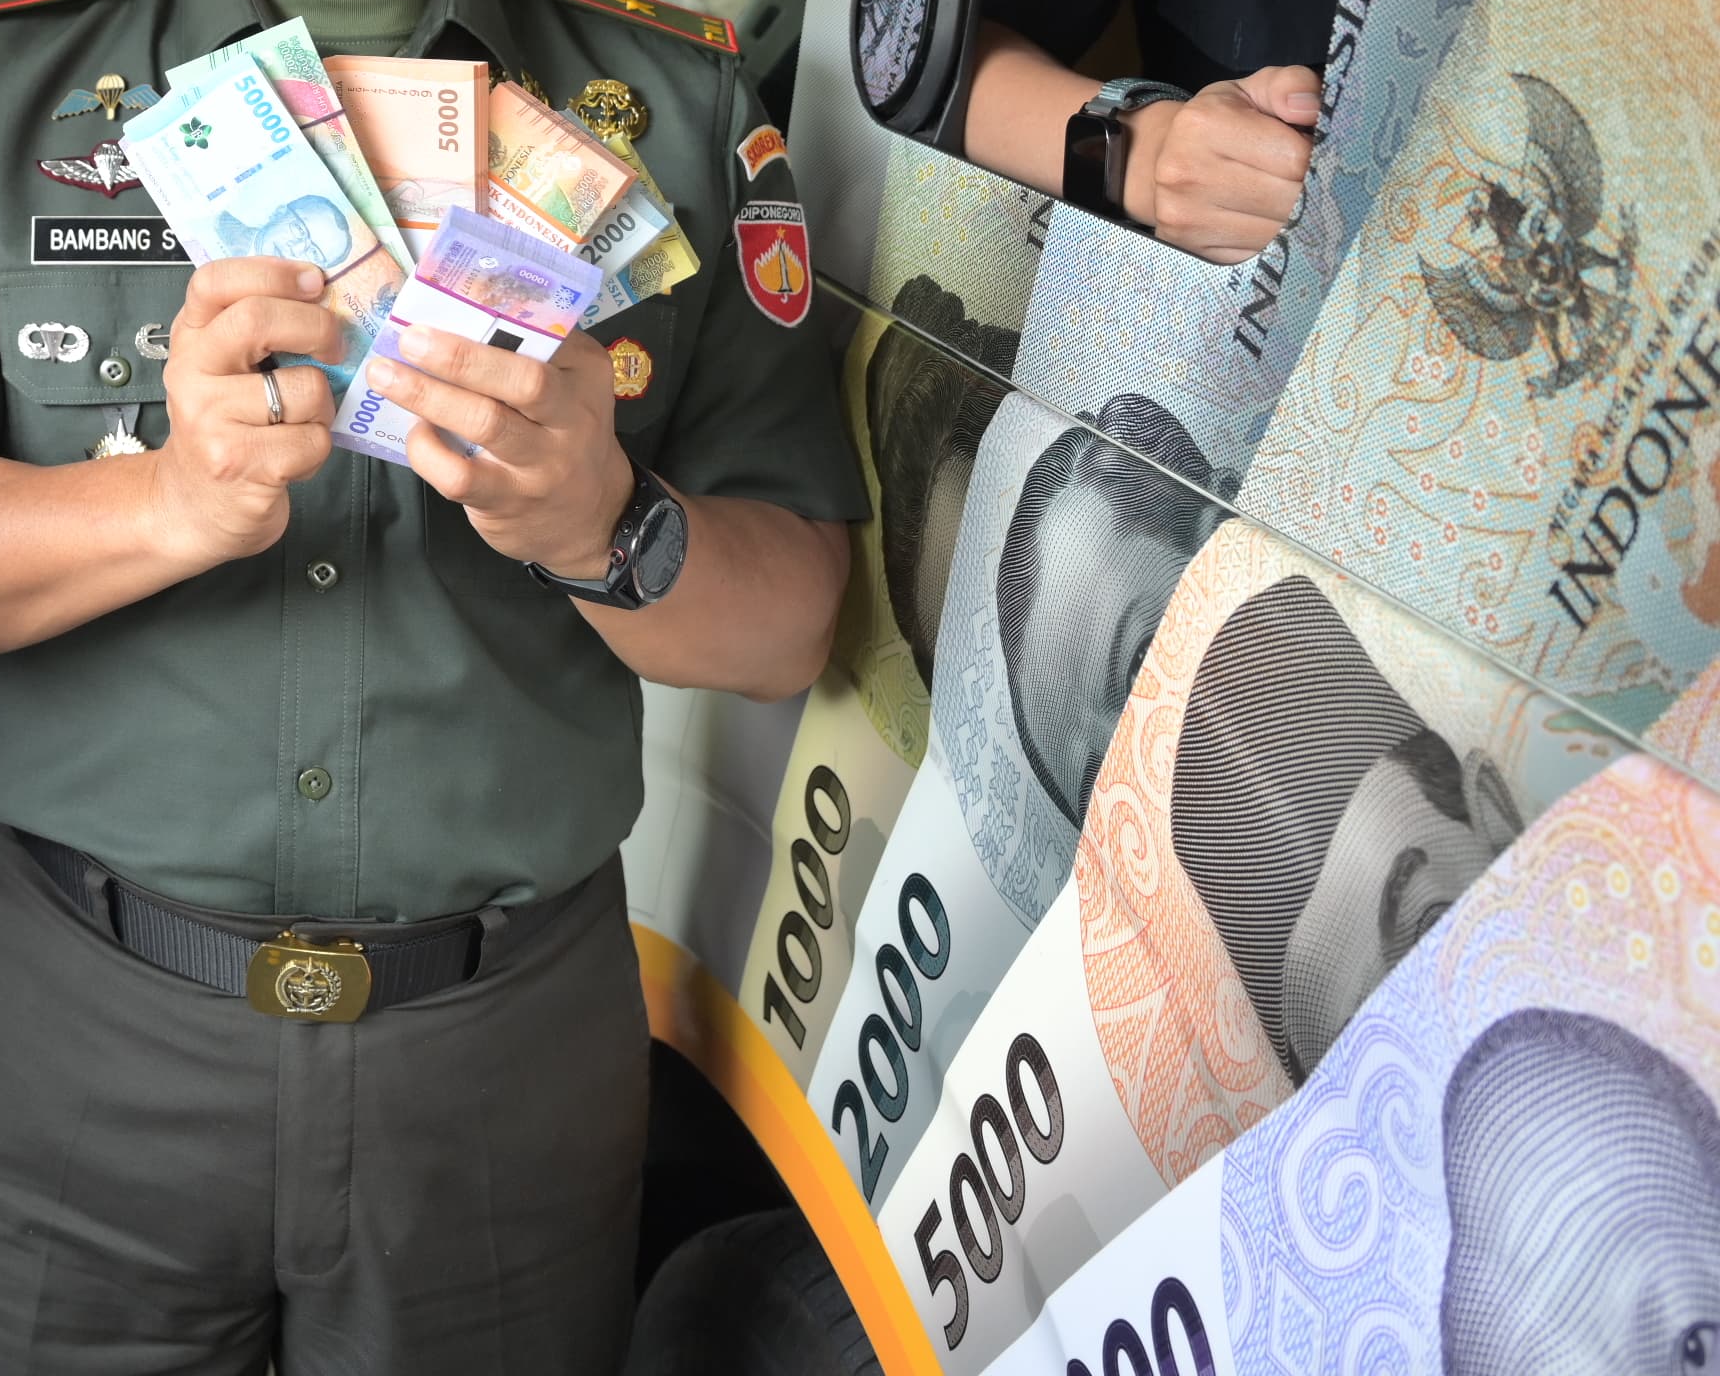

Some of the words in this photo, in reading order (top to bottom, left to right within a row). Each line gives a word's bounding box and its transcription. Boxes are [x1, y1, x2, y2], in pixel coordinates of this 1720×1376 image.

[234, 75, 290, 144] 50000
[438, 88, 459, 153] 5000
[575, 168, 598, 194] 5000
[50, 228, 151, 251] BAMBANG
[161, 228, 176, 251] S
[502, 197, 571, 252] INDONESIA
[580, 212, 636, 265] 2000
[740, 205, 801, 222] DIPONEGORO
[519, 269, 550, 286] 10000
[643, 249, 669, 268] 1000
[763, 764, 852, 1050] 1000
[832, 872, 950, 1203] 2000
[914, 1032, 1065, 1351] 5000
